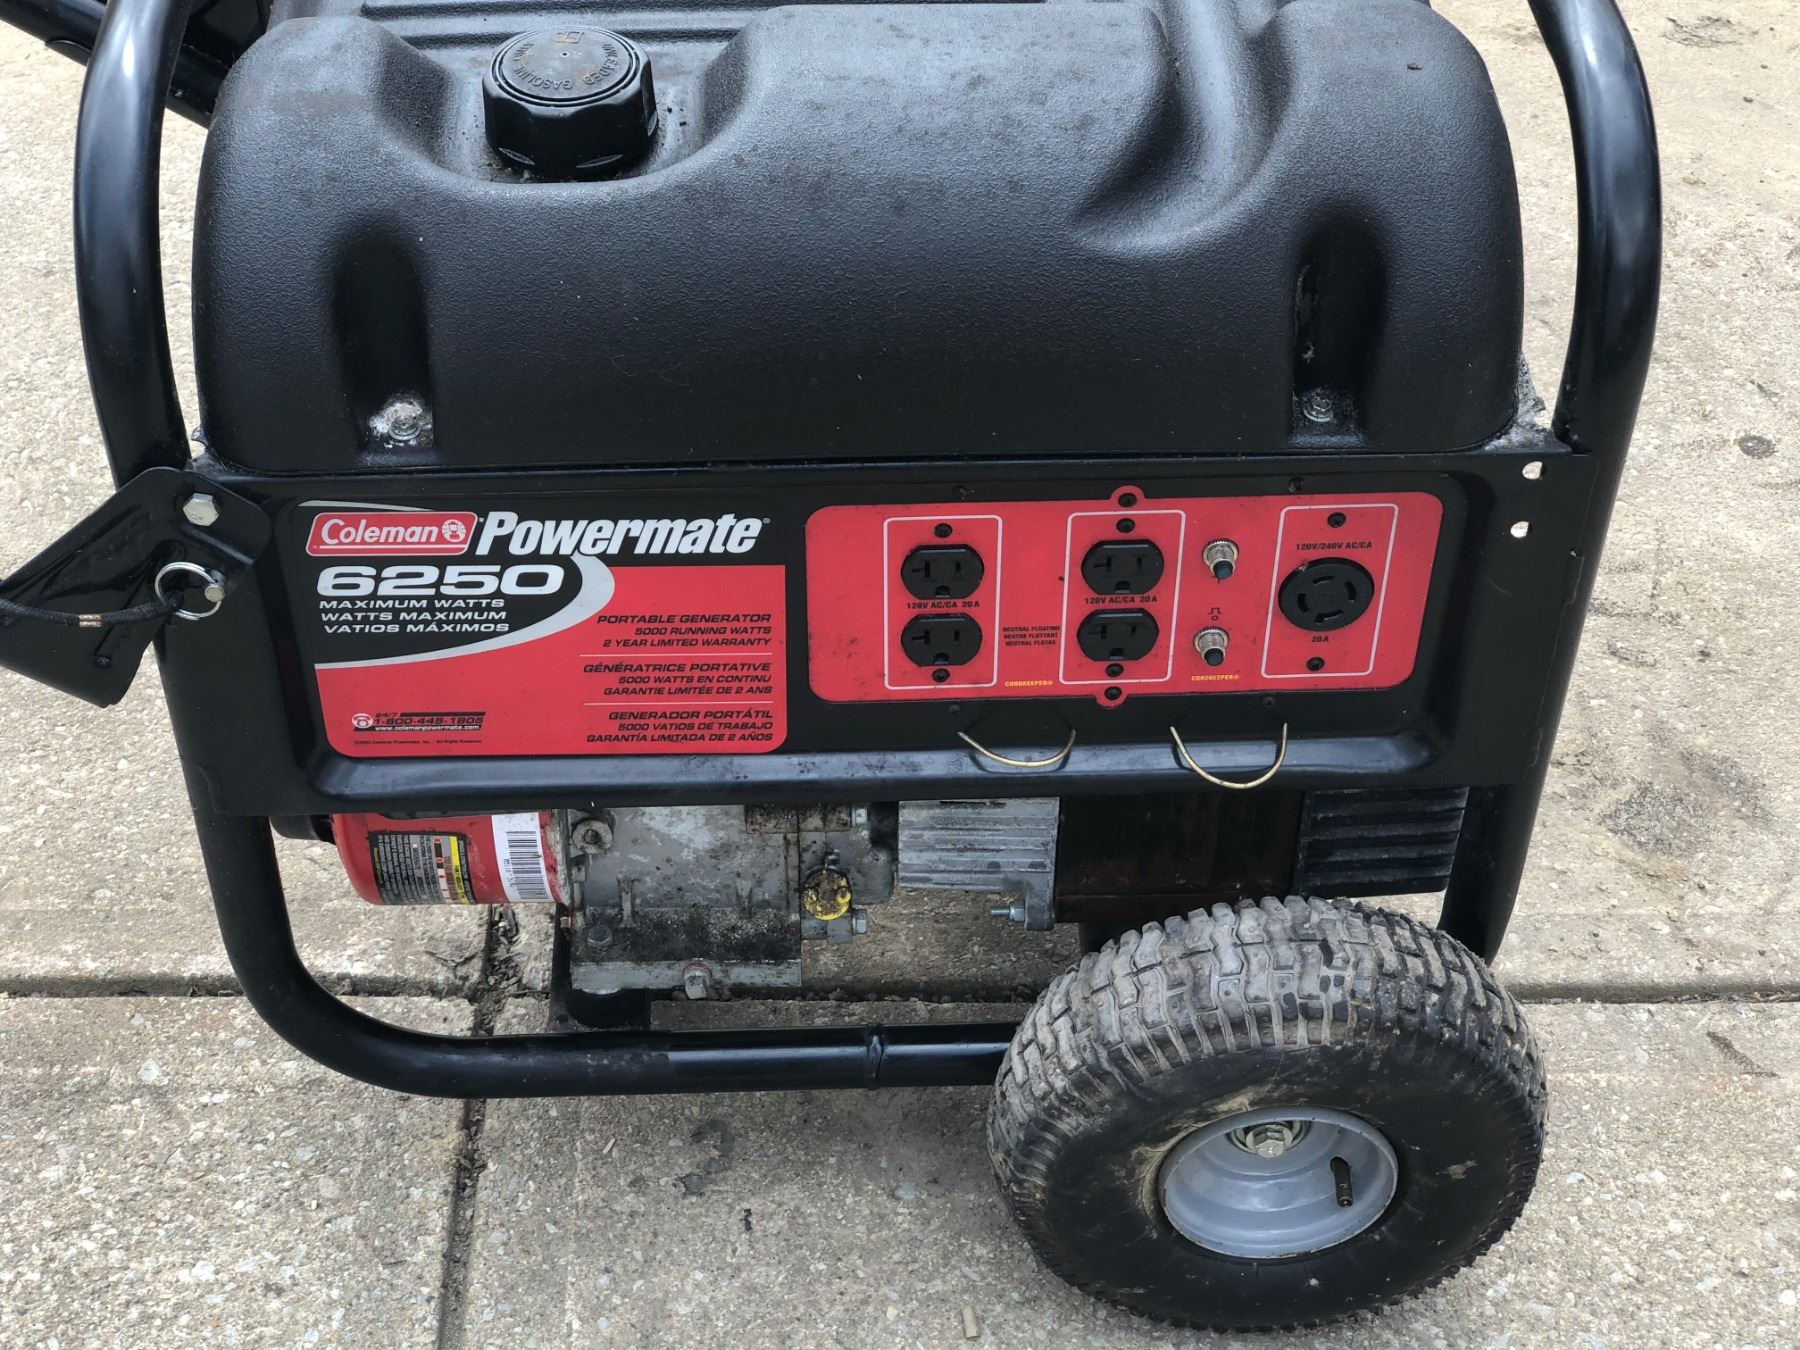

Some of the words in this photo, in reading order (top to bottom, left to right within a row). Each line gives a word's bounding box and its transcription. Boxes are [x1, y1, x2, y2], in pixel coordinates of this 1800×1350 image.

[513, 64, 573, 90] GASOLINE
[321, 518, 439, 544] Coleman
[1296, 542, 1343, 550] 120V/240V
[317, 564, 564, 596] 6250
[320, 599, 427, 609] MAXIMUM
[434, 599, 504, 608] WATTS
[321, 612, 393, 621] WATTS
[400, 611, 506, 620] MAXIMUM
[597, 615, 676, 623] PORTABLE
[680, 614, 771, 623] GENERATOR
[324, 624, 399, 633] VATIOS
[406, 622, 509, 632] MÁXIMOS
[635, 627, 667, 635] 5000
[670, 627, 726, 635] RUNNING
[702, 638, 771, 646] WARRANTY
[584, 662, 685, 672] GÉNÉRATRICE
[689, 663, 771, 671] PORTATIVE
[604, 687, 664, 695] GARANTIE
[668, 685, 712, 695] LIMITÉE
[609, 711, 699, 720] GENERADOR
[704, 708, 773, 719] PORTÁTIL
[618, 723, 649, 731] 5000
[587, 733, 647, 742] GARANTÍA
[650, 734, 705, 743] LIMITADA
[739, 733, 773, 741] AÑOS
